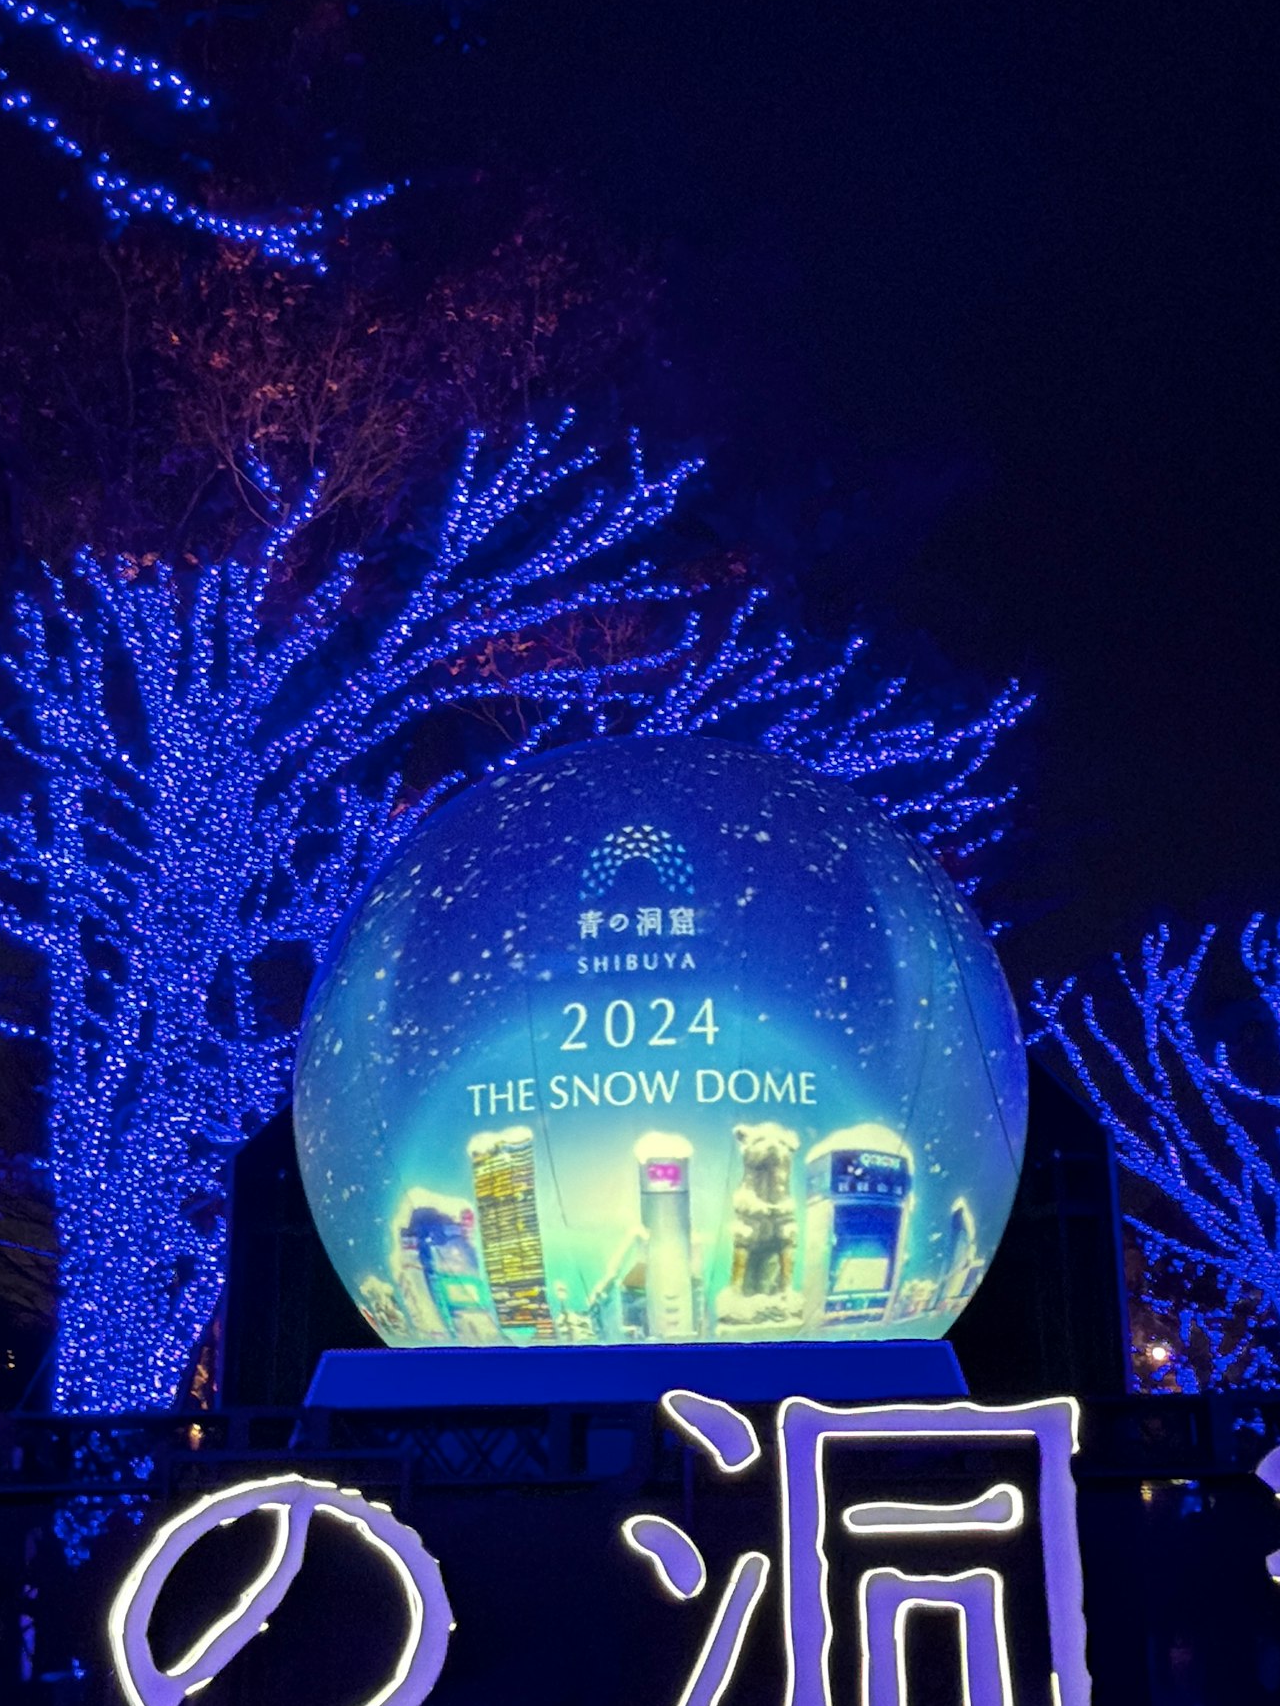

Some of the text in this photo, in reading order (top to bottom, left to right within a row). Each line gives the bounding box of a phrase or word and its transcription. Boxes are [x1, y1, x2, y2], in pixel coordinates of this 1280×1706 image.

[577, 906, 696, 939] 青の洞窟
[577, 952, 696, 974] SHIBUYA
[560, 998, 719, 1050] 2024
[467, 1069, 817, 1116] THE SNOW DOME
